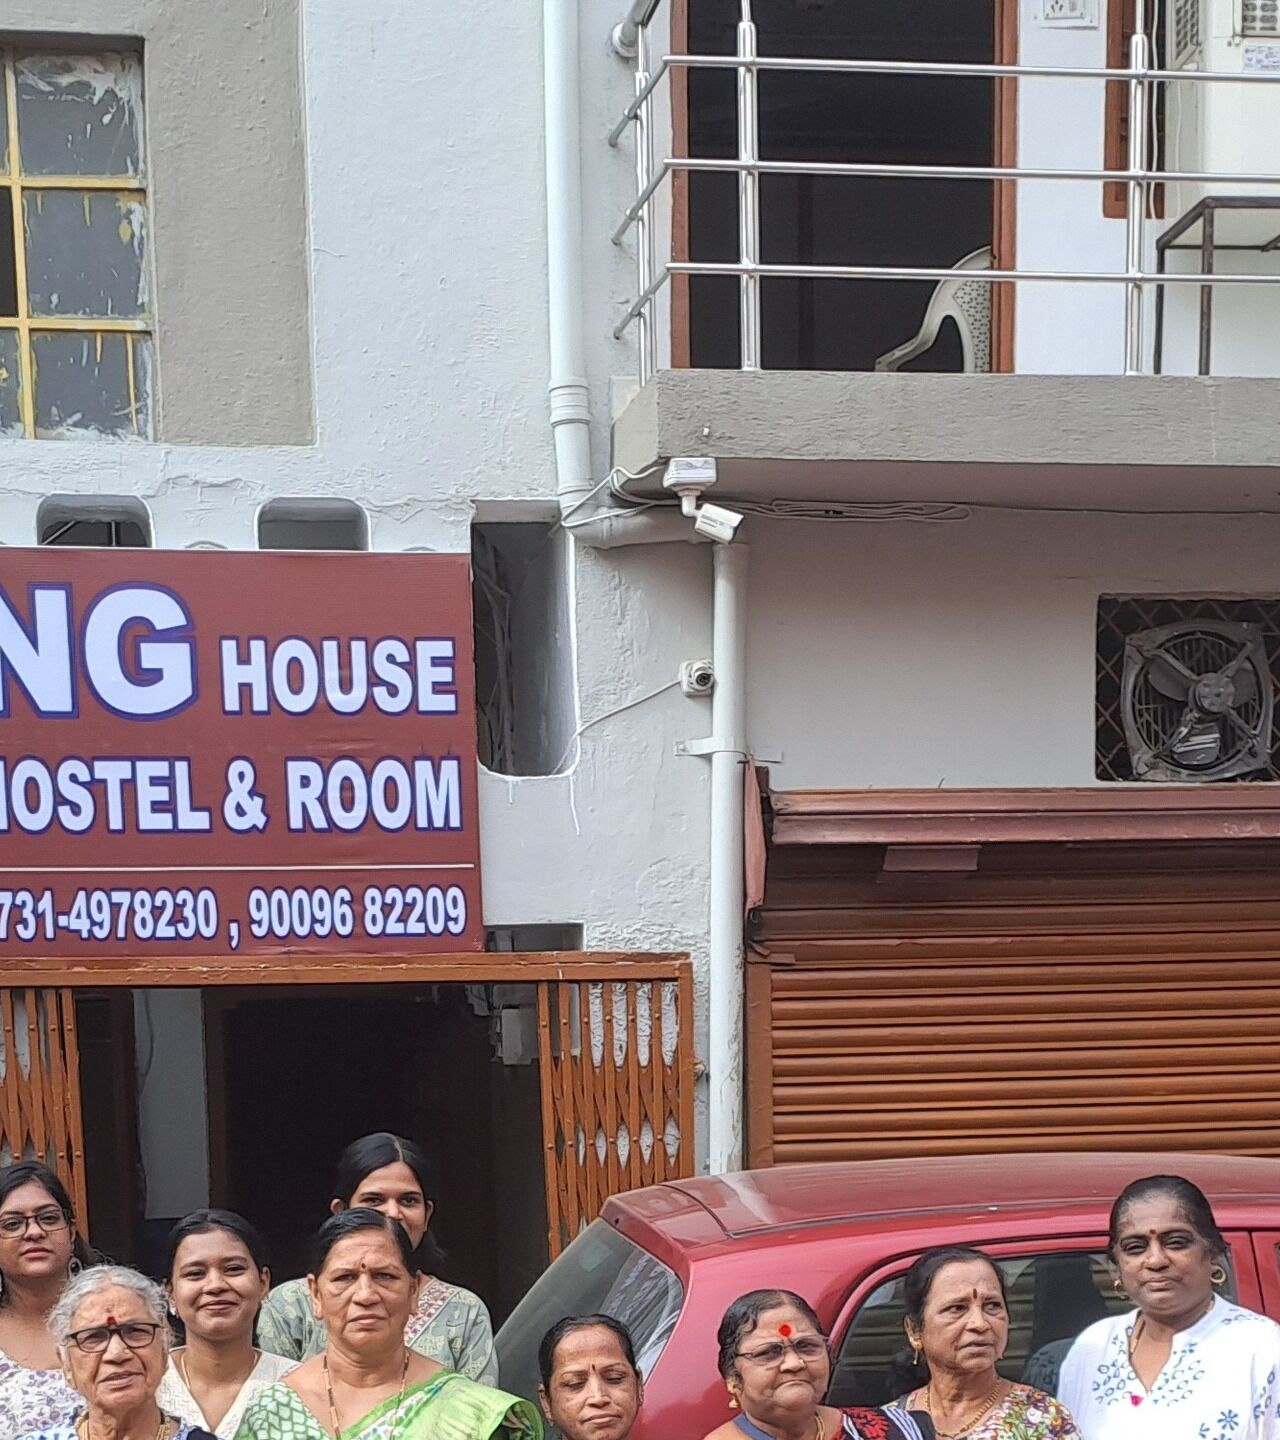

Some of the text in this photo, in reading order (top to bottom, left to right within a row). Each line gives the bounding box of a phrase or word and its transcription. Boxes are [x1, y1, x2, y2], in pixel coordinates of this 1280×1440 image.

[220, 637, 457, 716] HOUSE
[223, 757, 268, 832] &
[285, 757, 462, 832] ROOM
[249, 887, 353, 938] 90096
[363, 886, 467, 937] 82209
